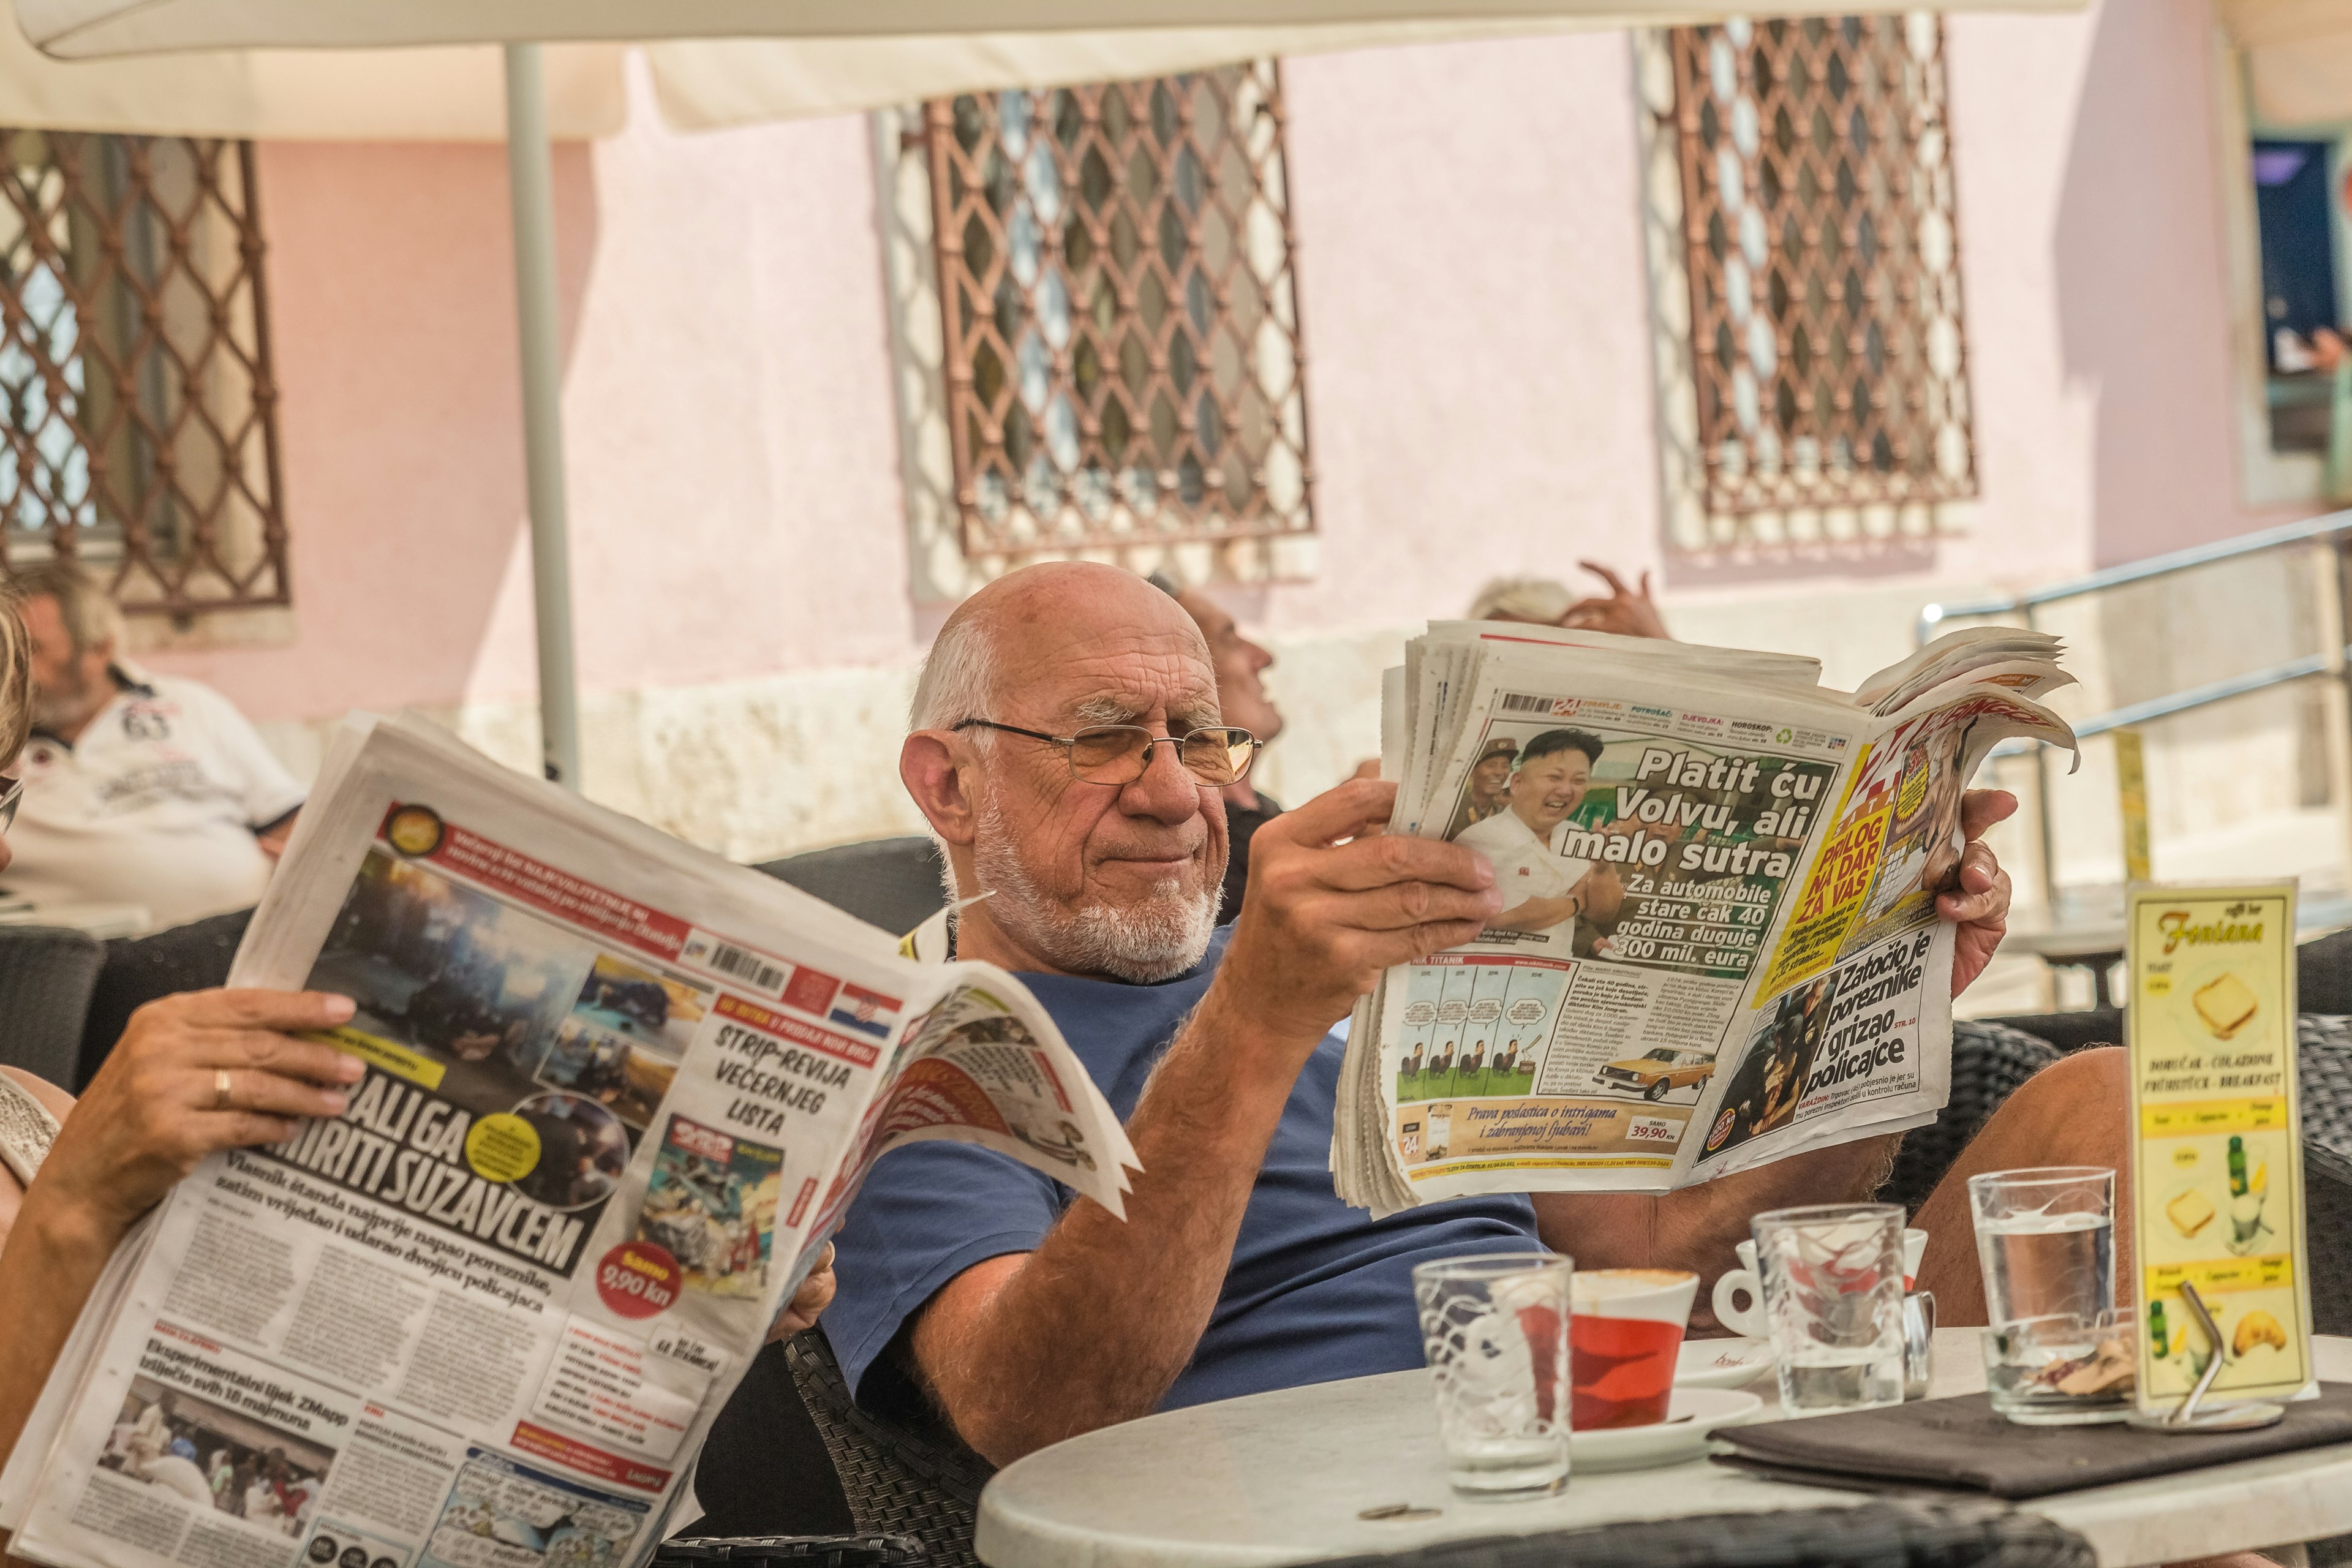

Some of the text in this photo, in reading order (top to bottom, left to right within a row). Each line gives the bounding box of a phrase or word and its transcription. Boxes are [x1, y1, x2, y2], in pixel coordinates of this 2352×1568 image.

[1631, 704, 1673, 718] POTROŠAČ:
[1681, 713, 1724, 725] DJEVOJKA:
[1731, 720, 1773, 733] HOROSKOP:
[1637, 748, 1823, 801] Platit ću
[1616, 787, 1811, 840] Volvu, ali
[1561, 829, 1791, 878] malo sutra
[1819, 815, 1883, 872] PRILOG
[1809, 840, 1880, 899] NA DAR
[1626, 874, 1771, 905] Za automobile
[1796, 869, 1869, 924] ZA VAS
[1638, 899, 1765, 926] stare čak 40
[1616, 919, 1756, 951] godina duguje
[1428, 954, 1464, 966] TITANIK
[1616, 939, 1749, 967] 300 mil. eura
[1836, 941, 1909, 998] Zatočio
[1909, 930, 1931, 968] je
[1572, 989, 1593, 997] poruka
[1619, 993, 1645, 1003] Šveđani-
[1577, 974, 1596, 983] Čekali
[1615, 981, 1636, 990] godina,
[1618, 987, 1649, 998] desetljeće,
[1825, 963, 1923, 1031] poreznike
[1567, 1001, 1591, 1009] diktator
[1604, 1005, 1628, 1015] Jong-un.
[1580, 996, 1599, 1005] poslao
[1600, 997, 1646, 1011] sjevernokorejski
[1815, 1008, 1896, 1063] i grizao
[1893, 1017, 1917, 1030] STR. 10
[714, 1022, 853, 1091] STRIP-REVIJA
[1803, 1035, 1905, 1100] policajce
[715, 1057, 827, 1115] VEČERNJEG
[1796, 1094, 1831, 1110] VARAŽDIN:
[1829, 1090, 1850, 1101] Trgovac
[1860, 1074, 1890, 1089] pobjesnio
[1888, 1074, 1896, 1084] je
[1895, 1072, 1906, 1082] jer
[1802, 1103, 1824, 1118] porezni
[1822, 1095, 1850, 1110] inspektori
[1866, 1085, 1893, 1097] kontrolu
[1893, 1080, 1917, 1091] računa
[409, 1096, 472, 1164] GA
[726, 1098, 787, 1136] LISTA
[1464, 1101, 1618, 1125] Prava poslastica o intrigama
[1402, 1136, 1420, 1155] 24
[1479, 1118, 1592, 1147] i zabranjenoj ljubavi!
[1630, 1124, 1667, 1141] 39,90
[286, 1175, 349, 1215] štanda
[412, 1229, 466, 1264] napao
[380, 1148, 584, 1271] SUZAVCEM
[401, 1244, 467, 1286] dvojicu
[461, 1268, 548, 1319] policajaca
[646, 1283, 671, 1307] kn
